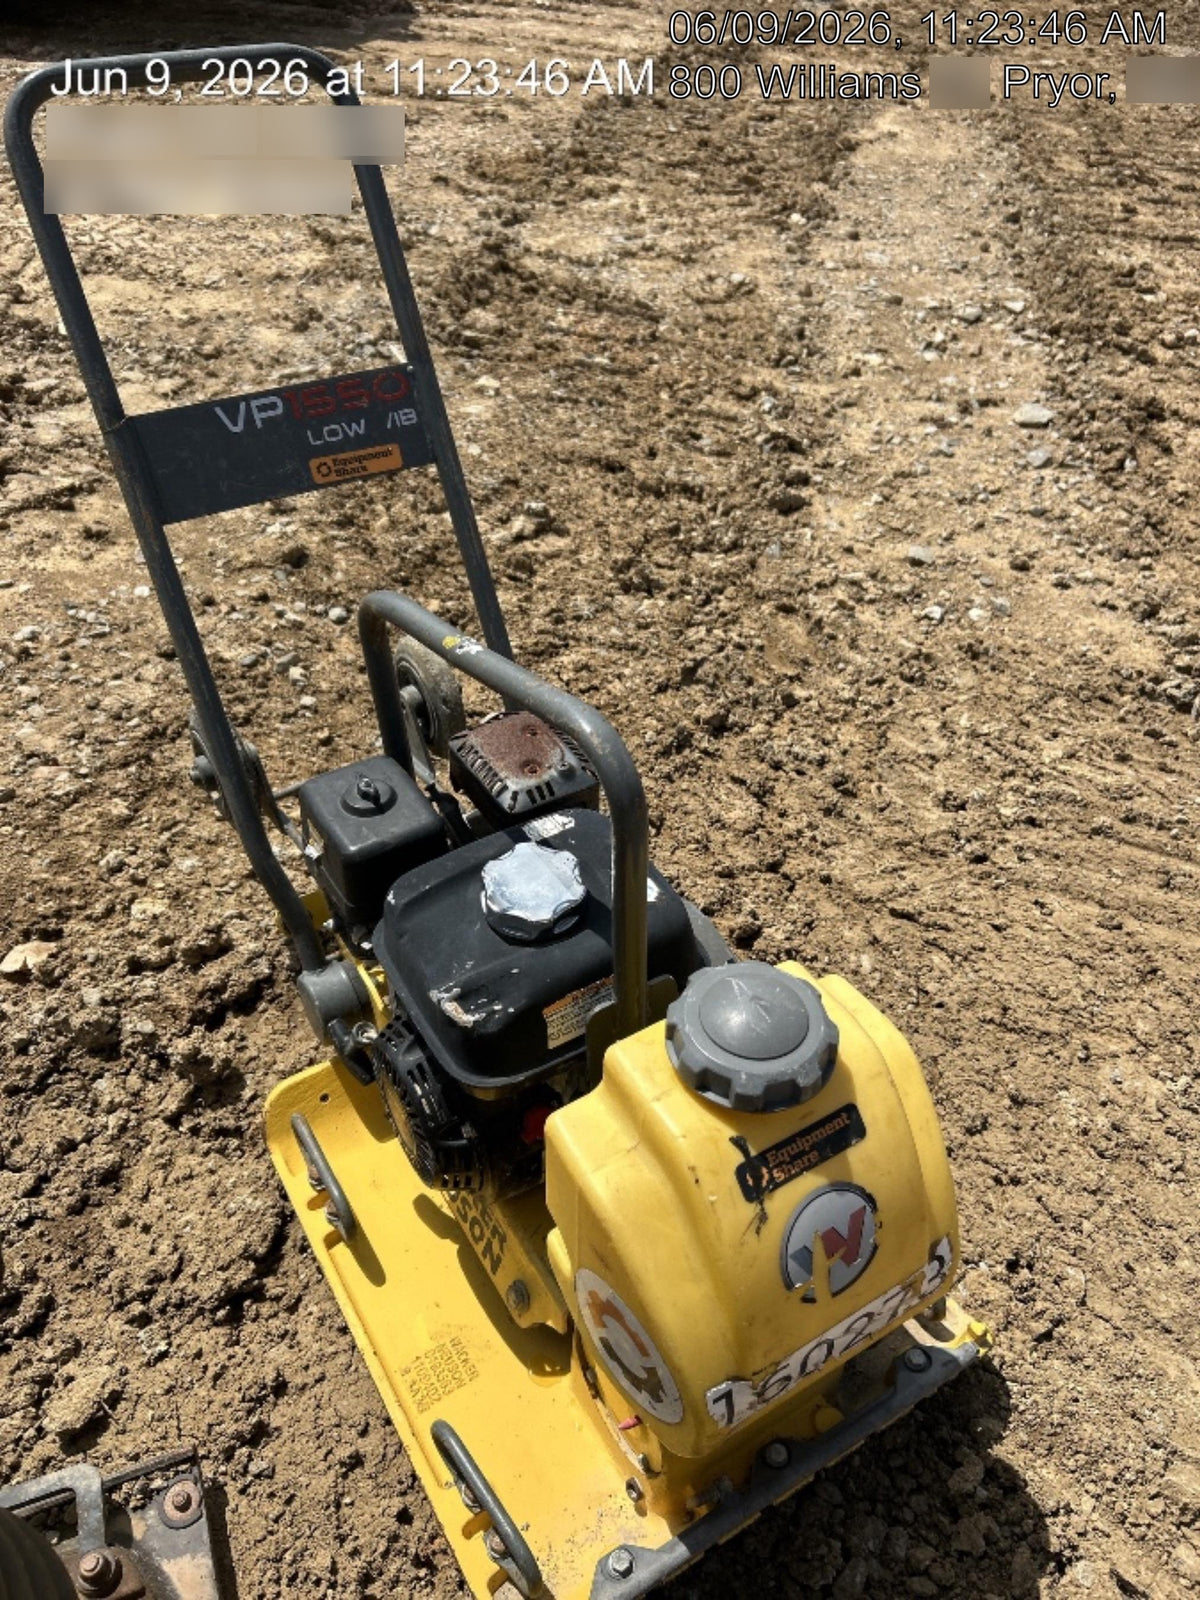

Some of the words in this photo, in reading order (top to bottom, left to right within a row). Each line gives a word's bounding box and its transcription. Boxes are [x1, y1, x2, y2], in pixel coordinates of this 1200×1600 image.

[307, 419, 366, 446] LOW
[333, 448, 393, 468] Equipment
[766, 1113, 851, 1166] Equipment
[773, 1149, 820, 1182] Share
